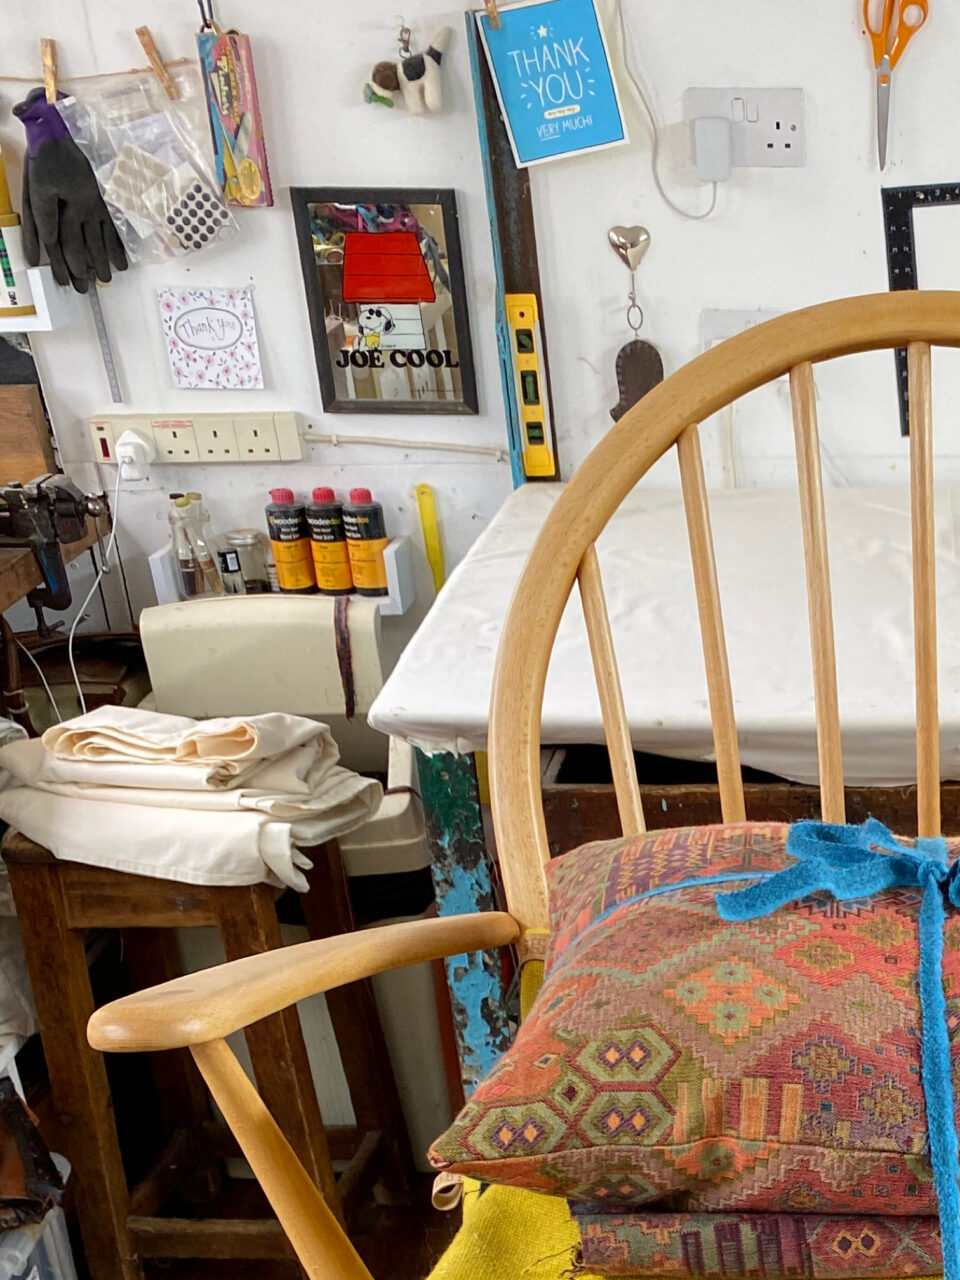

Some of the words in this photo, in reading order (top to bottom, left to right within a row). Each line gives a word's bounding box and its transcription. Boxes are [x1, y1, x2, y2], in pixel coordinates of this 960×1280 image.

[507, 37, 590, 77] THANK
[528, 70, 584, 107] YOU
[536, 121, 561, 138] VERY
[562, 115, 592, 131] MUCH!
[7, 291, 18, 306] 3M
[178, 316, 215, 338] Thank
[336, 349, 385, 368] JOE
[389, 349, 459, 368] COOL
